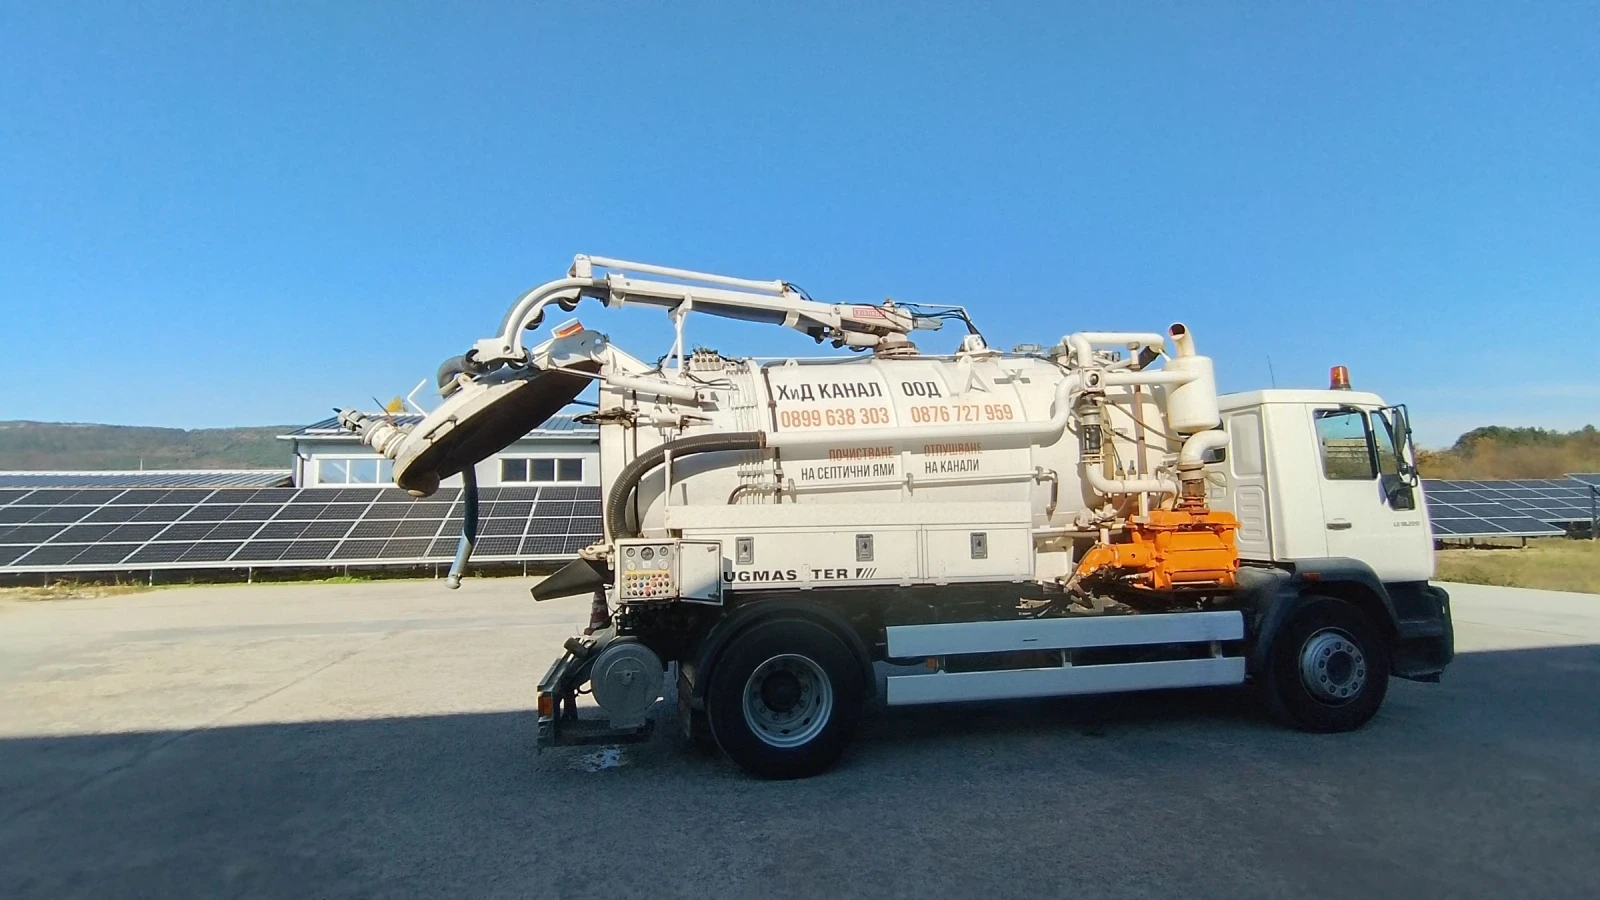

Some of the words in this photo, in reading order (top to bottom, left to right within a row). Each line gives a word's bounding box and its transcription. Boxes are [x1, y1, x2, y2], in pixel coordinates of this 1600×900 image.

[776, 383, 815, 402] ХиД
[817, 382, 883, 399] КАНАЛ
[901, 381, 942, 398] ООД
[780, 409, 822, 428] 0899
[825, 408, 856, 426] 638
[859, 407, 889, 425] 303
[910, 405, 950, 423] 0876
[952, 404, 980, 422] 727
[984, 403, 1014, 421] 959
[828, 446, 894, 462] ПОЧИСТВАНЕ
[924, 442, 983, 457] ОТПУШВАНЕ
[801, 467, 815, 481] НА
[817, 464, 871, 480] СЕПТИЧНИ
[872, 463, 895, 477] ЯМИ
[924, 461, 938, 474] НА
[940, 458, 980, 473] КАНАЛИ
